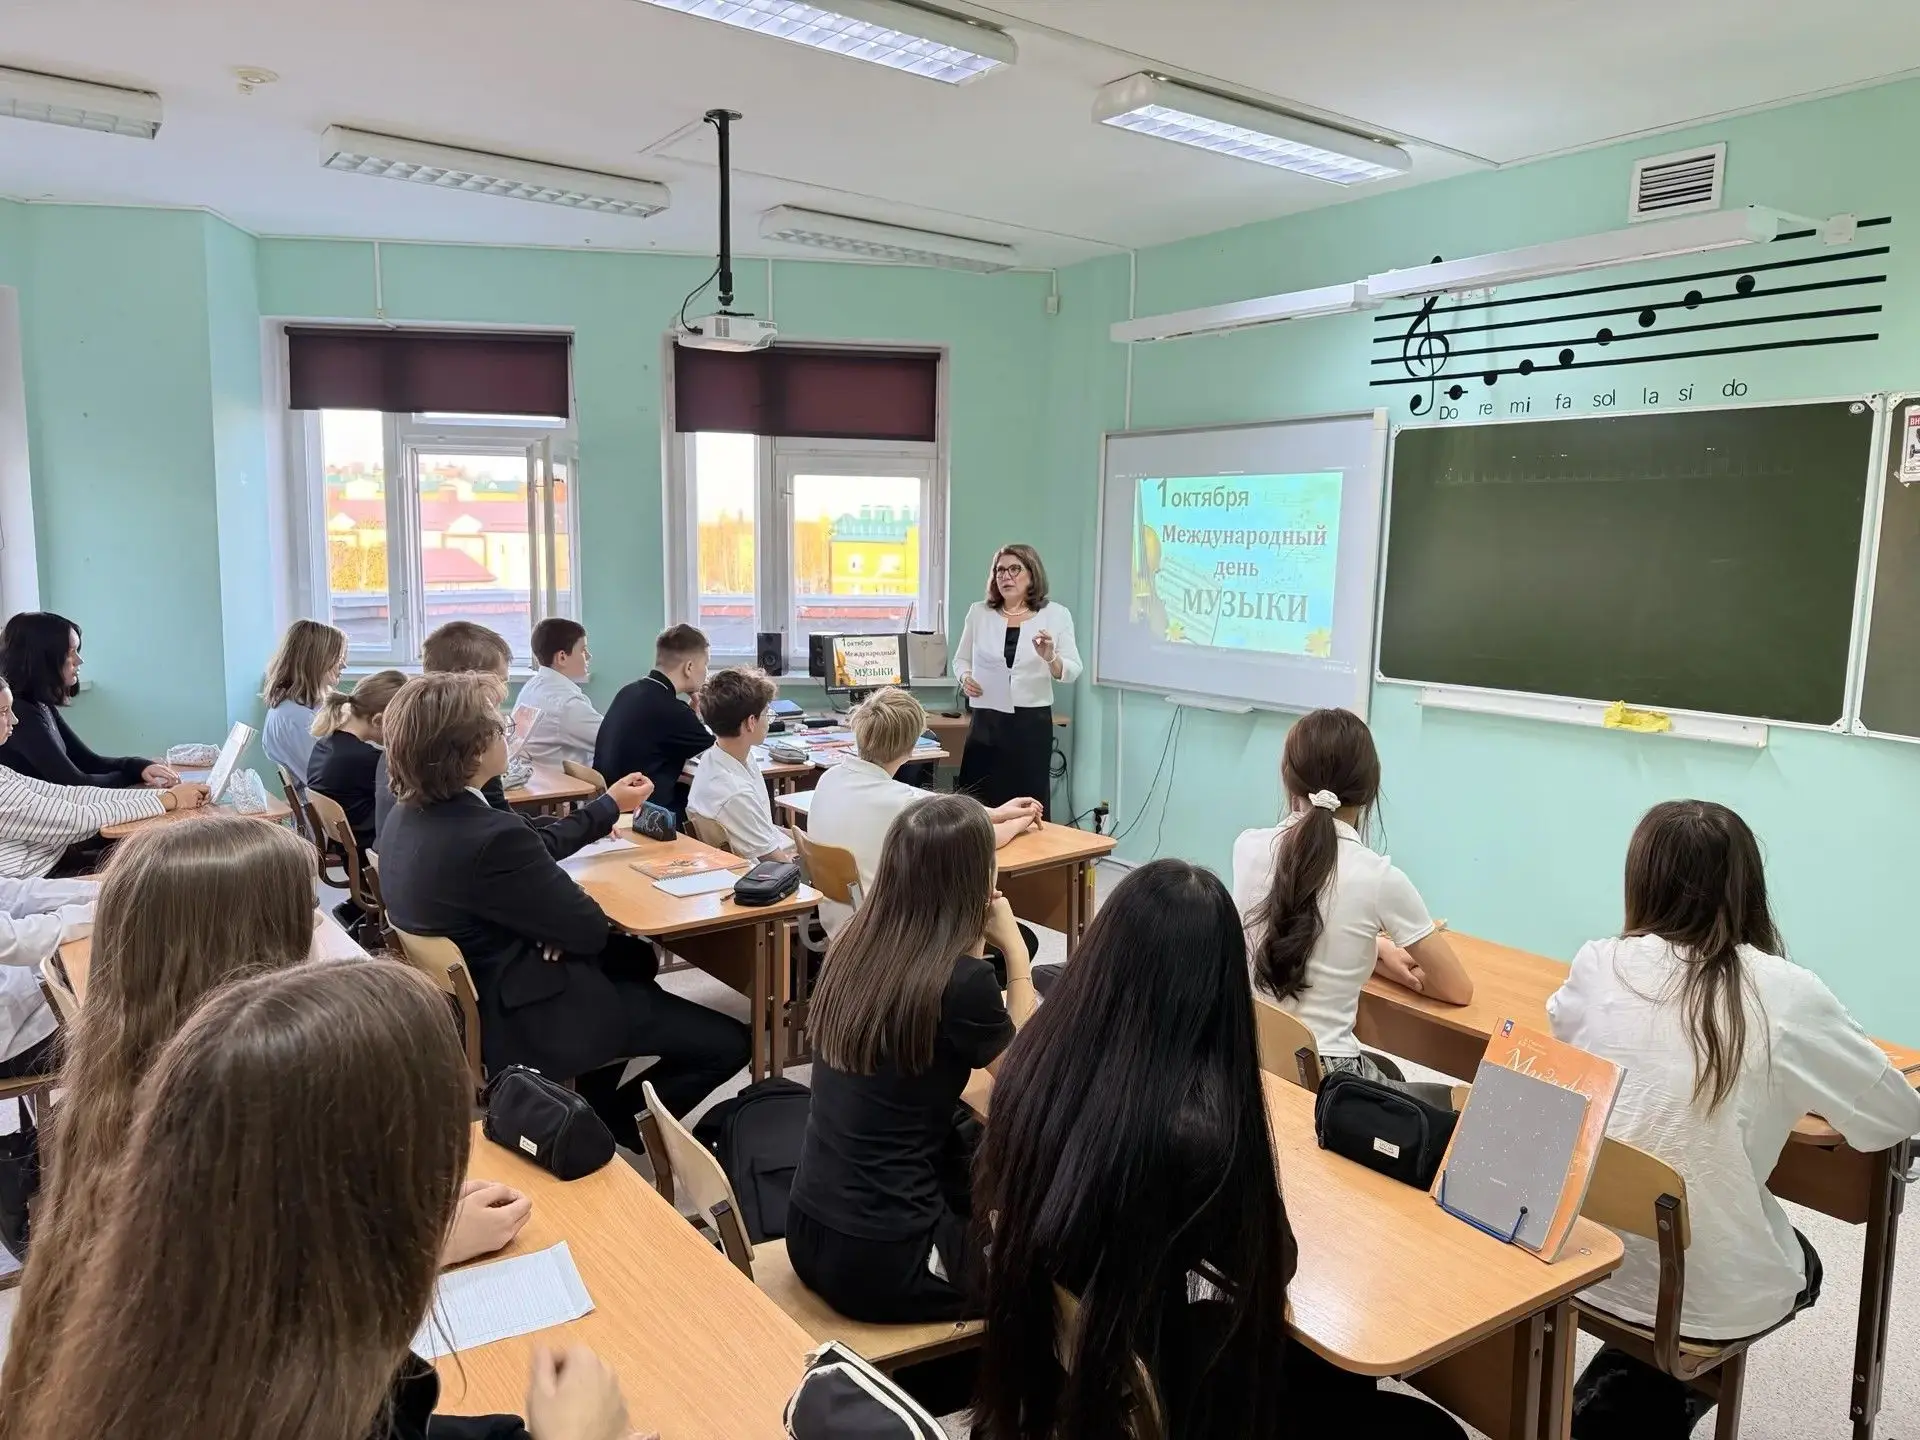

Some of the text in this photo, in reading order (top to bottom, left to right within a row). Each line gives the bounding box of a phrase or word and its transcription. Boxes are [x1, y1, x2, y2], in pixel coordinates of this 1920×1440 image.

[1440, 378, 1748, 420] Do re mi fa sol la si do
[1157, 478, 1249, 511] 1 октября
[1162, 524, 1328, 549] Международный
[1214, 560, 1259, 579] день
[1183, 588, 1308, 623] МУЗЫКИ
[854, 668, 894, 677] МУЗЫКИ
